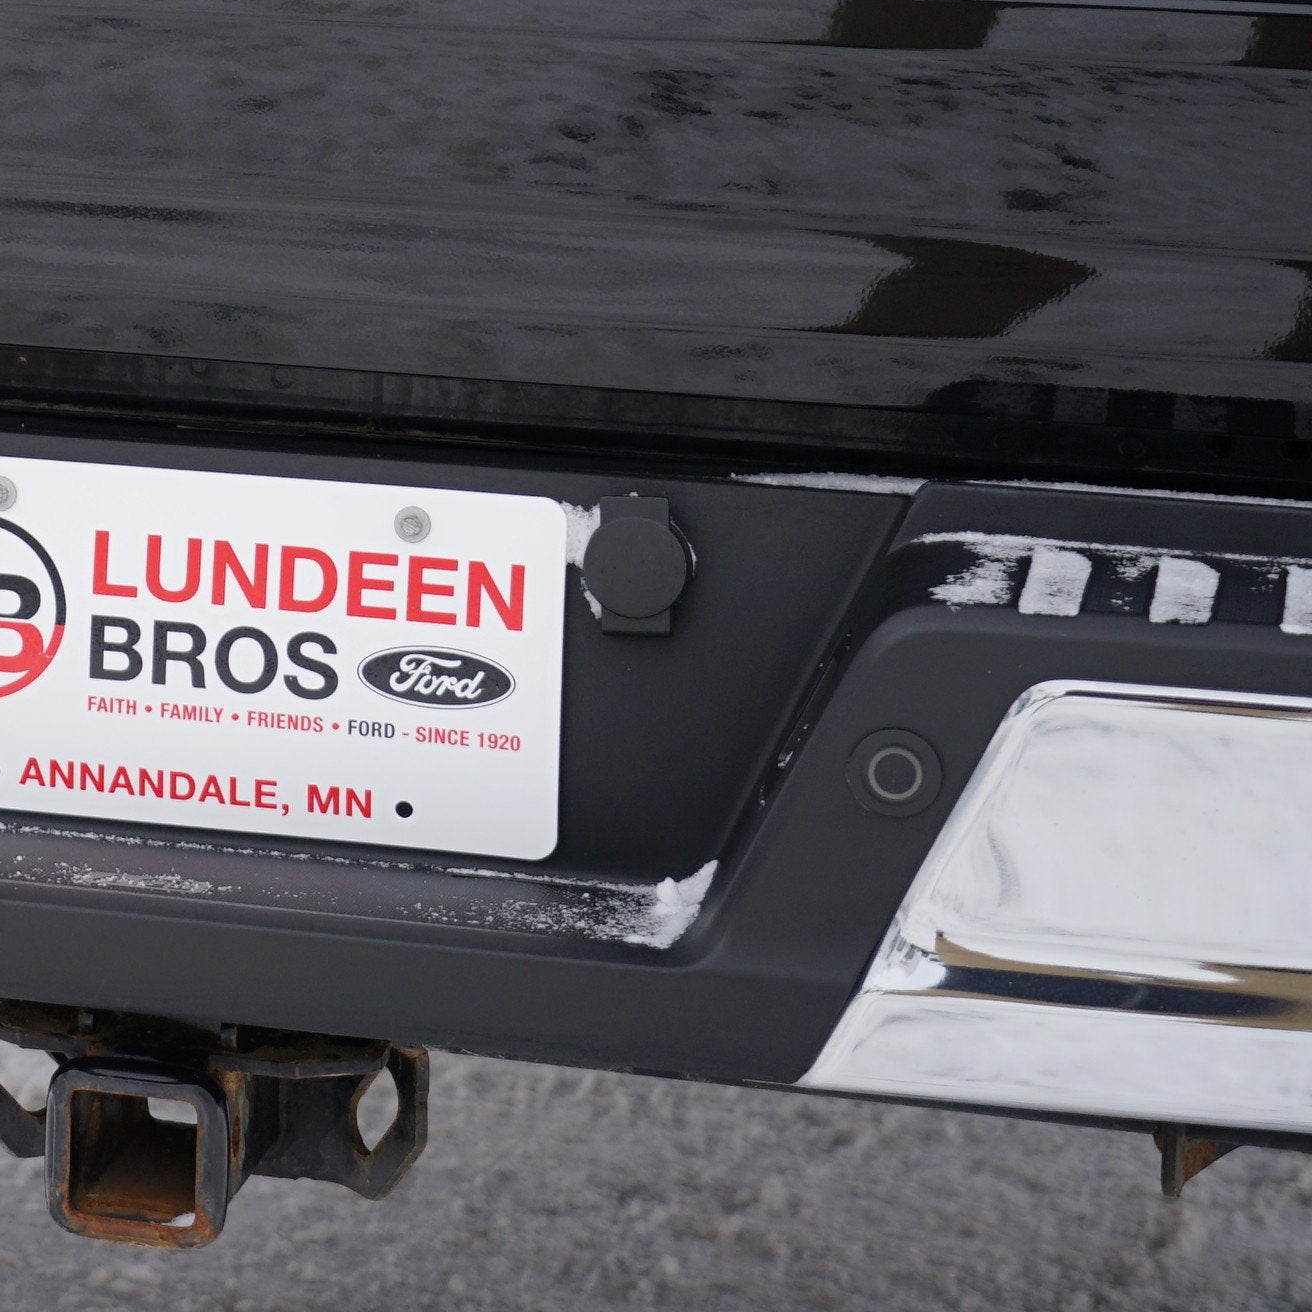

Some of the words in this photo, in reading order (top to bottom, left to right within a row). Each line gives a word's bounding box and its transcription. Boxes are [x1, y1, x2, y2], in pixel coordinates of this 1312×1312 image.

[91, 530, 526, 632] LUNDEEN
[87, 614, 340, 701] BROS
[87, 696, 137, 716] FAITH
[160, 702, 224, 724] FAMILY
[247, 710, 325, 734] FRIENDS
[347, 719, 397, 740] FORD
[415, 724, 470, 748] SINCE
[476, 731, 522, 753] 1920
[19, 756, 292, 817] ANNANDALE,
[307, 784, 373, 819] MN
